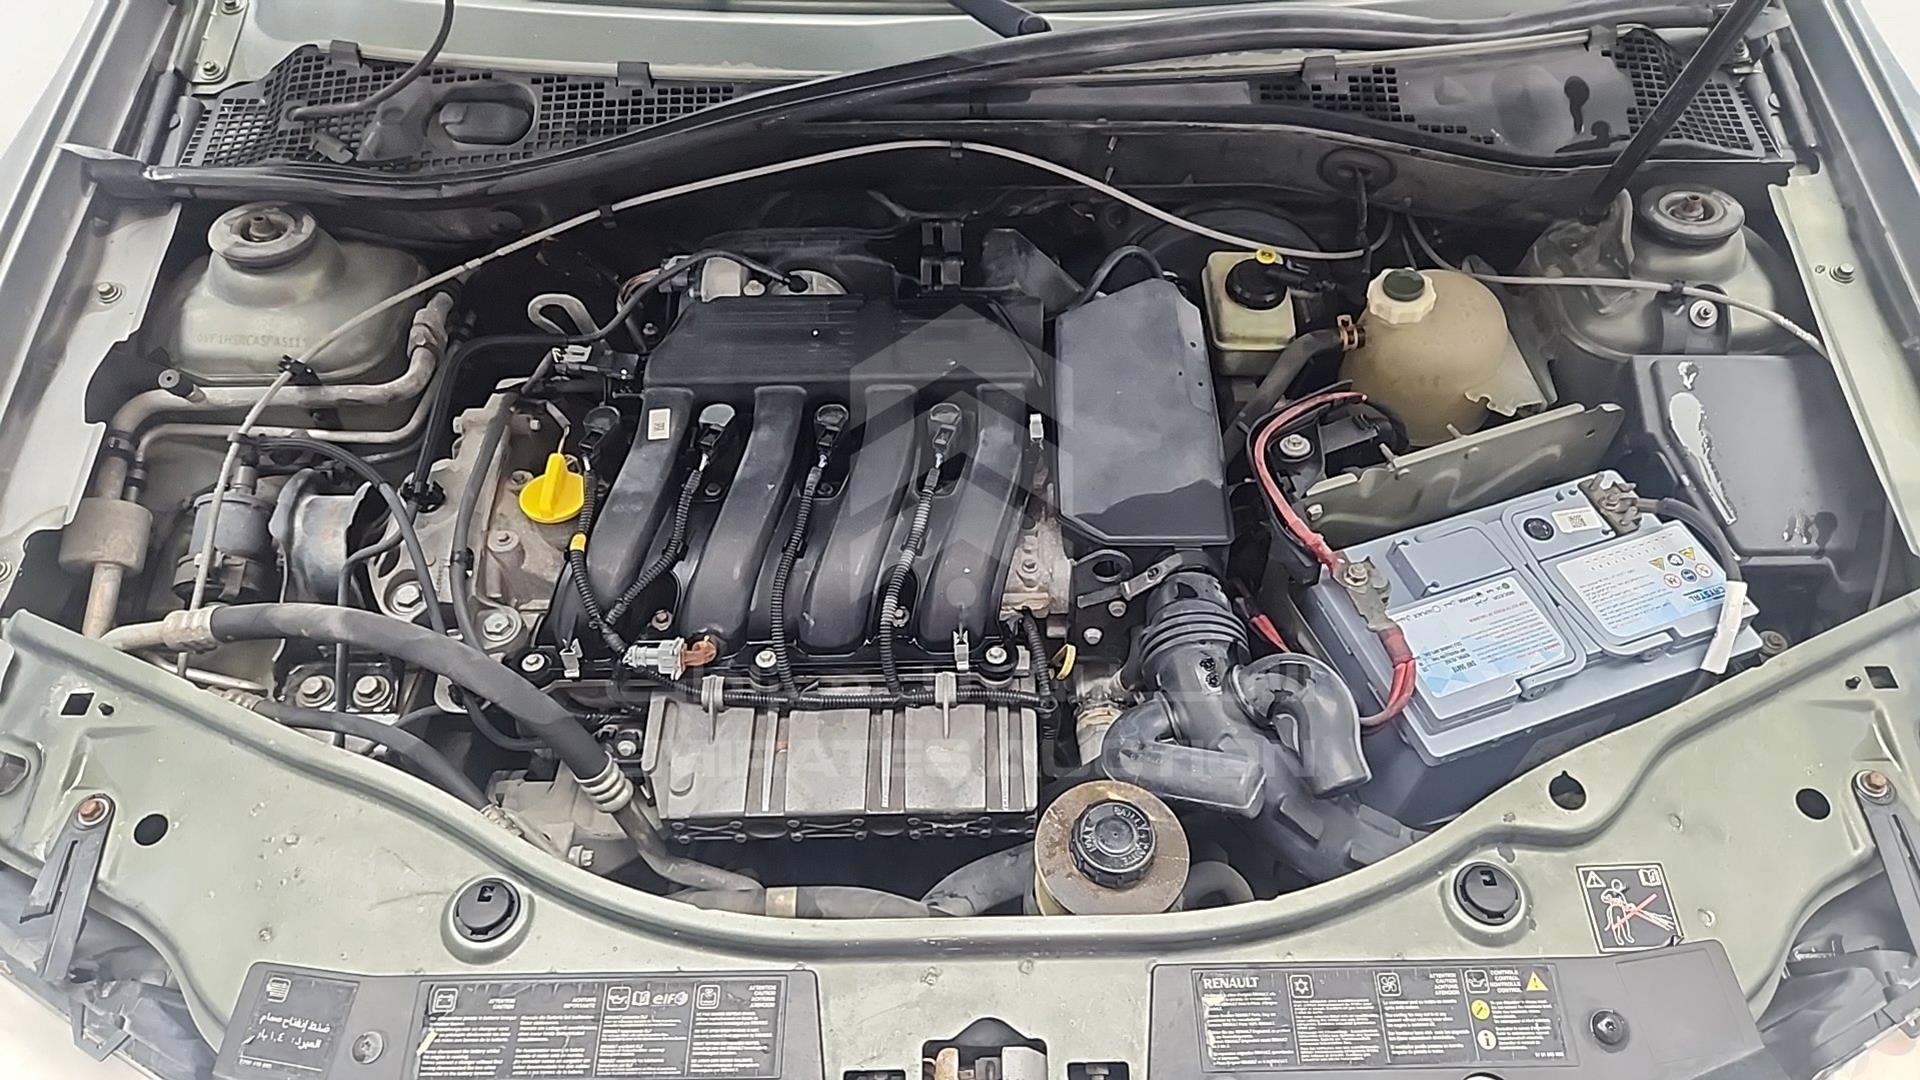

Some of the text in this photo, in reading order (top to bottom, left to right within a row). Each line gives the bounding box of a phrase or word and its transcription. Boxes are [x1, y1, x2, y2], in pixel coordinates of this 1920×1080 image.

[1689, 586, 1726, 602] CRYSTAL
[1203, 977, 1259, 989] RENAULT
[653, 993, 675, 1005] elf
